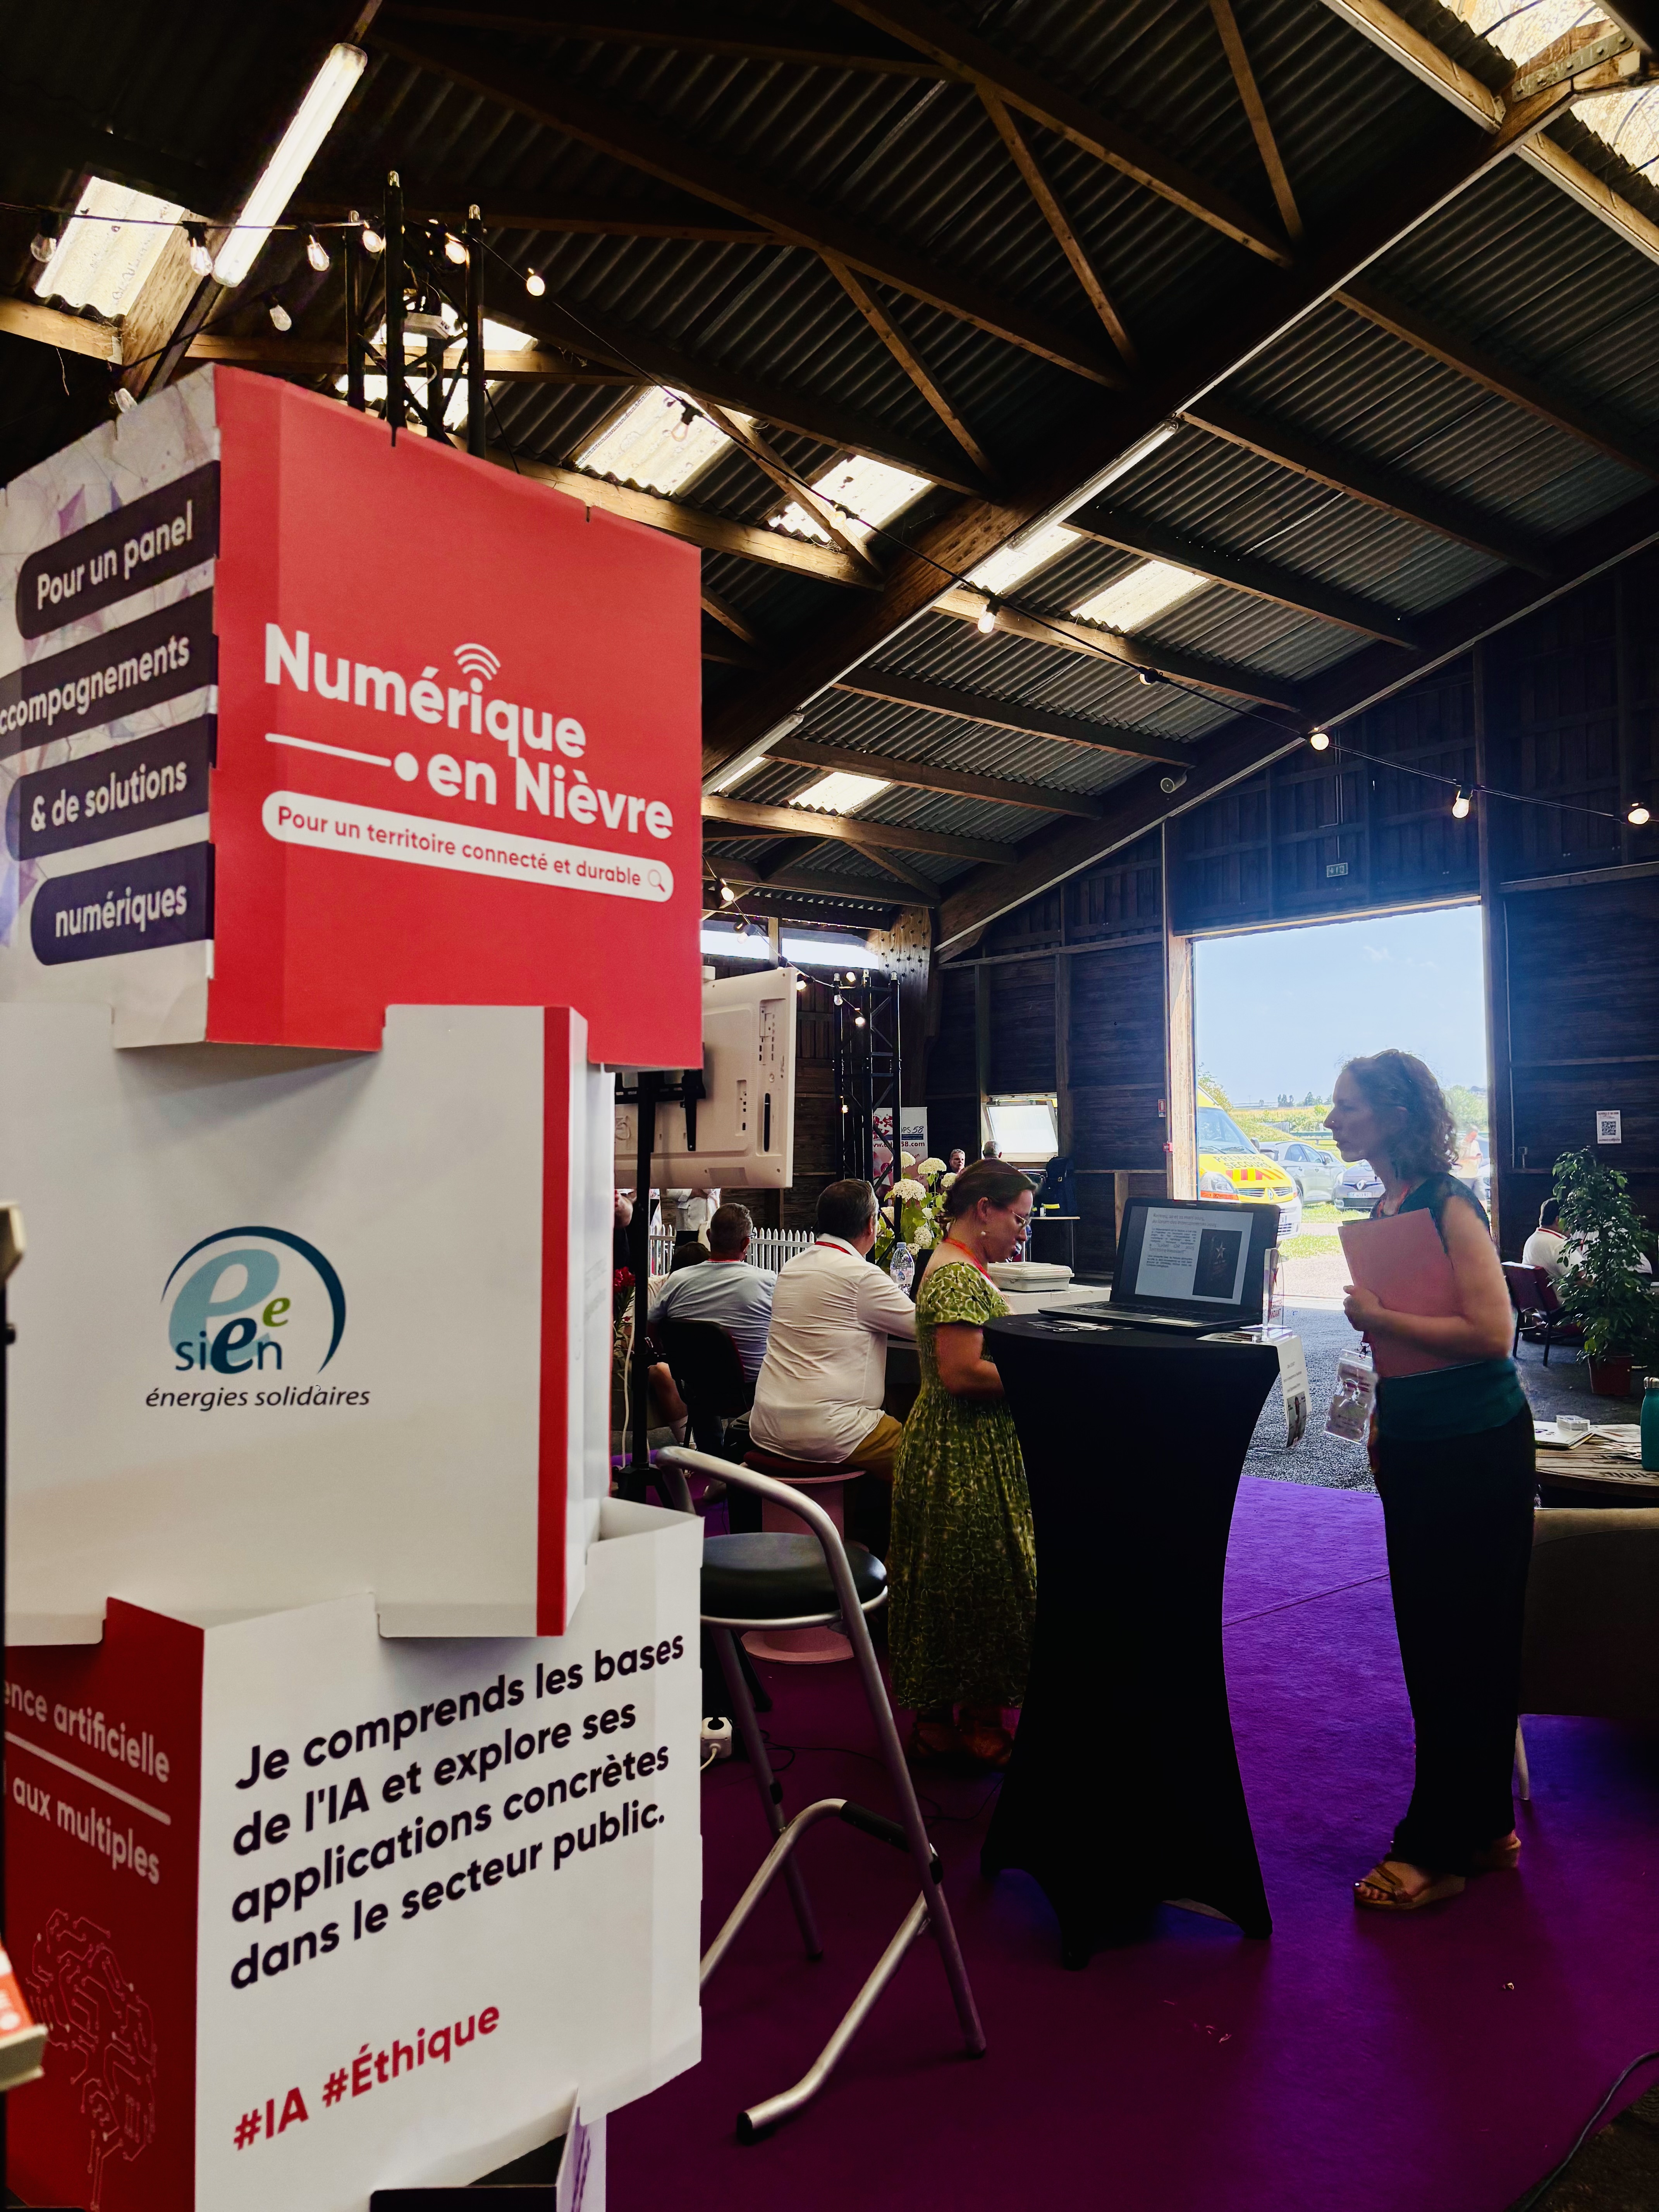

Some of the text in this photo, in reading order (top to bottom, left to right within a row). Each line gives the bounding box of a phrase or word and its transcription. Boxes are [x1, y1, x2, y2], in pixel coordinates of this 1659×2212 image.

[38, 500, 192, 610] Pour un panel
[265, 623, 587, 758] Numérique
[31, 762, 186, 831] & de solutions
[279, 806, 640, 886] Pour un territoire connecté et durable
[427, 754, 674, 840] en Nièvre
[56, 886, 187, 937] numériques
[911, 1125, 924, 1133] 58
[146, 1386, 370, 1412] énergies solidaires
[54, 1704, 169, 1783] artificielle
[235, 1635, 683, 1789] Je comprends les bases
[13, 1777, 159, 1884] aux multiples
[233, 1704, 636, 1855] de l'IA et explore ses
[232, 1746, 669, 1923] applications concrètes
[231, 1800, 664, 1989] dans le secteur public.
[234, 2007, 499, 2150] #IA #Éthique
